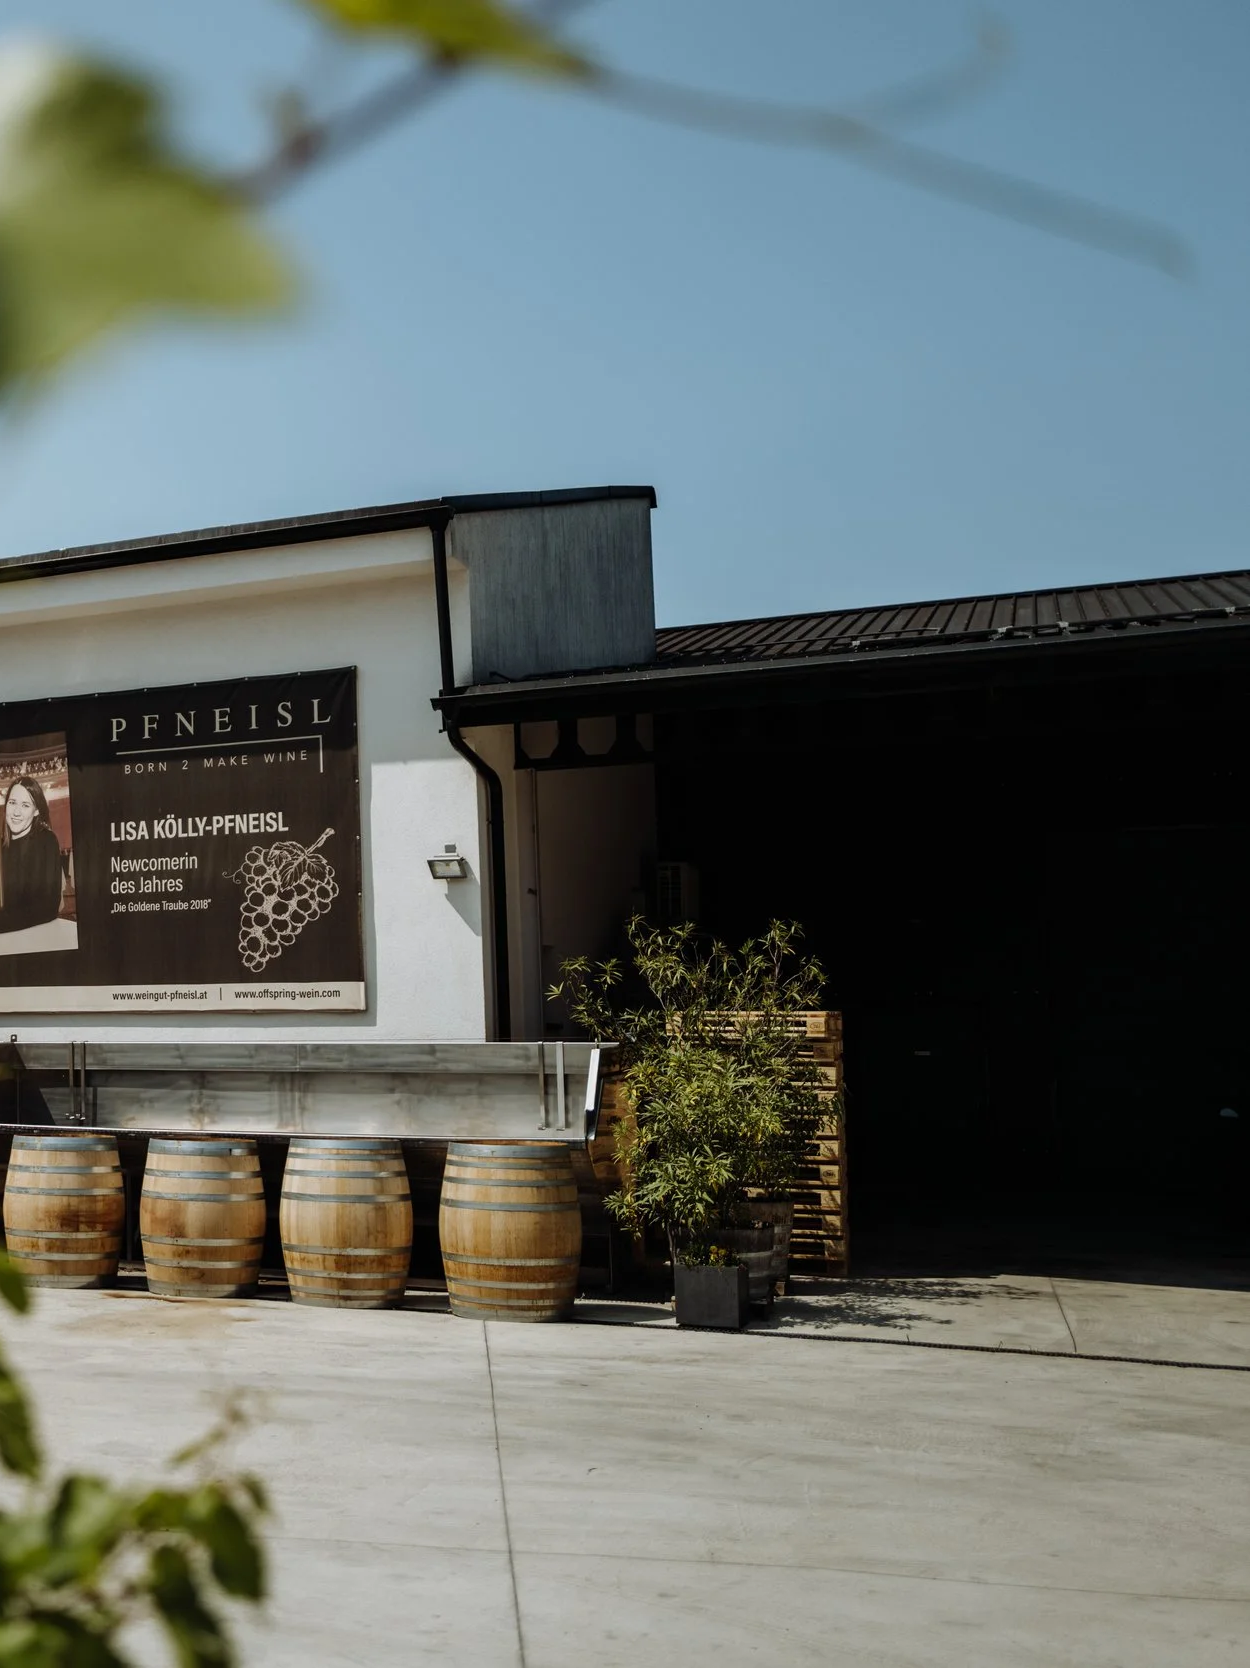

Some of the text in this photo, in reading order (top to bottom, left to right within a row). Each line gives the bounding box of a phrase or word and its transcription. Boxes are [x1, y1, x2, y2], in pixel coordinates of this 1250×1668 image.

[110, 699, 331, 742] PFNEISL
[124, 750, 308, 775] BORN 2 MAKE WINE
[110, 811, 289, 842] LISA KÖLLY-PFNEISL
[111, 852, 198, 873] Newcomerin
[111, 875, 183, 894] des Jahres
[127, 901, 160, 912] Goldene
[161, 900, 189, 911] Traube
[112, 988, 341, 1002] www.weingut-pfneisl.at www.offspring-wein.com
